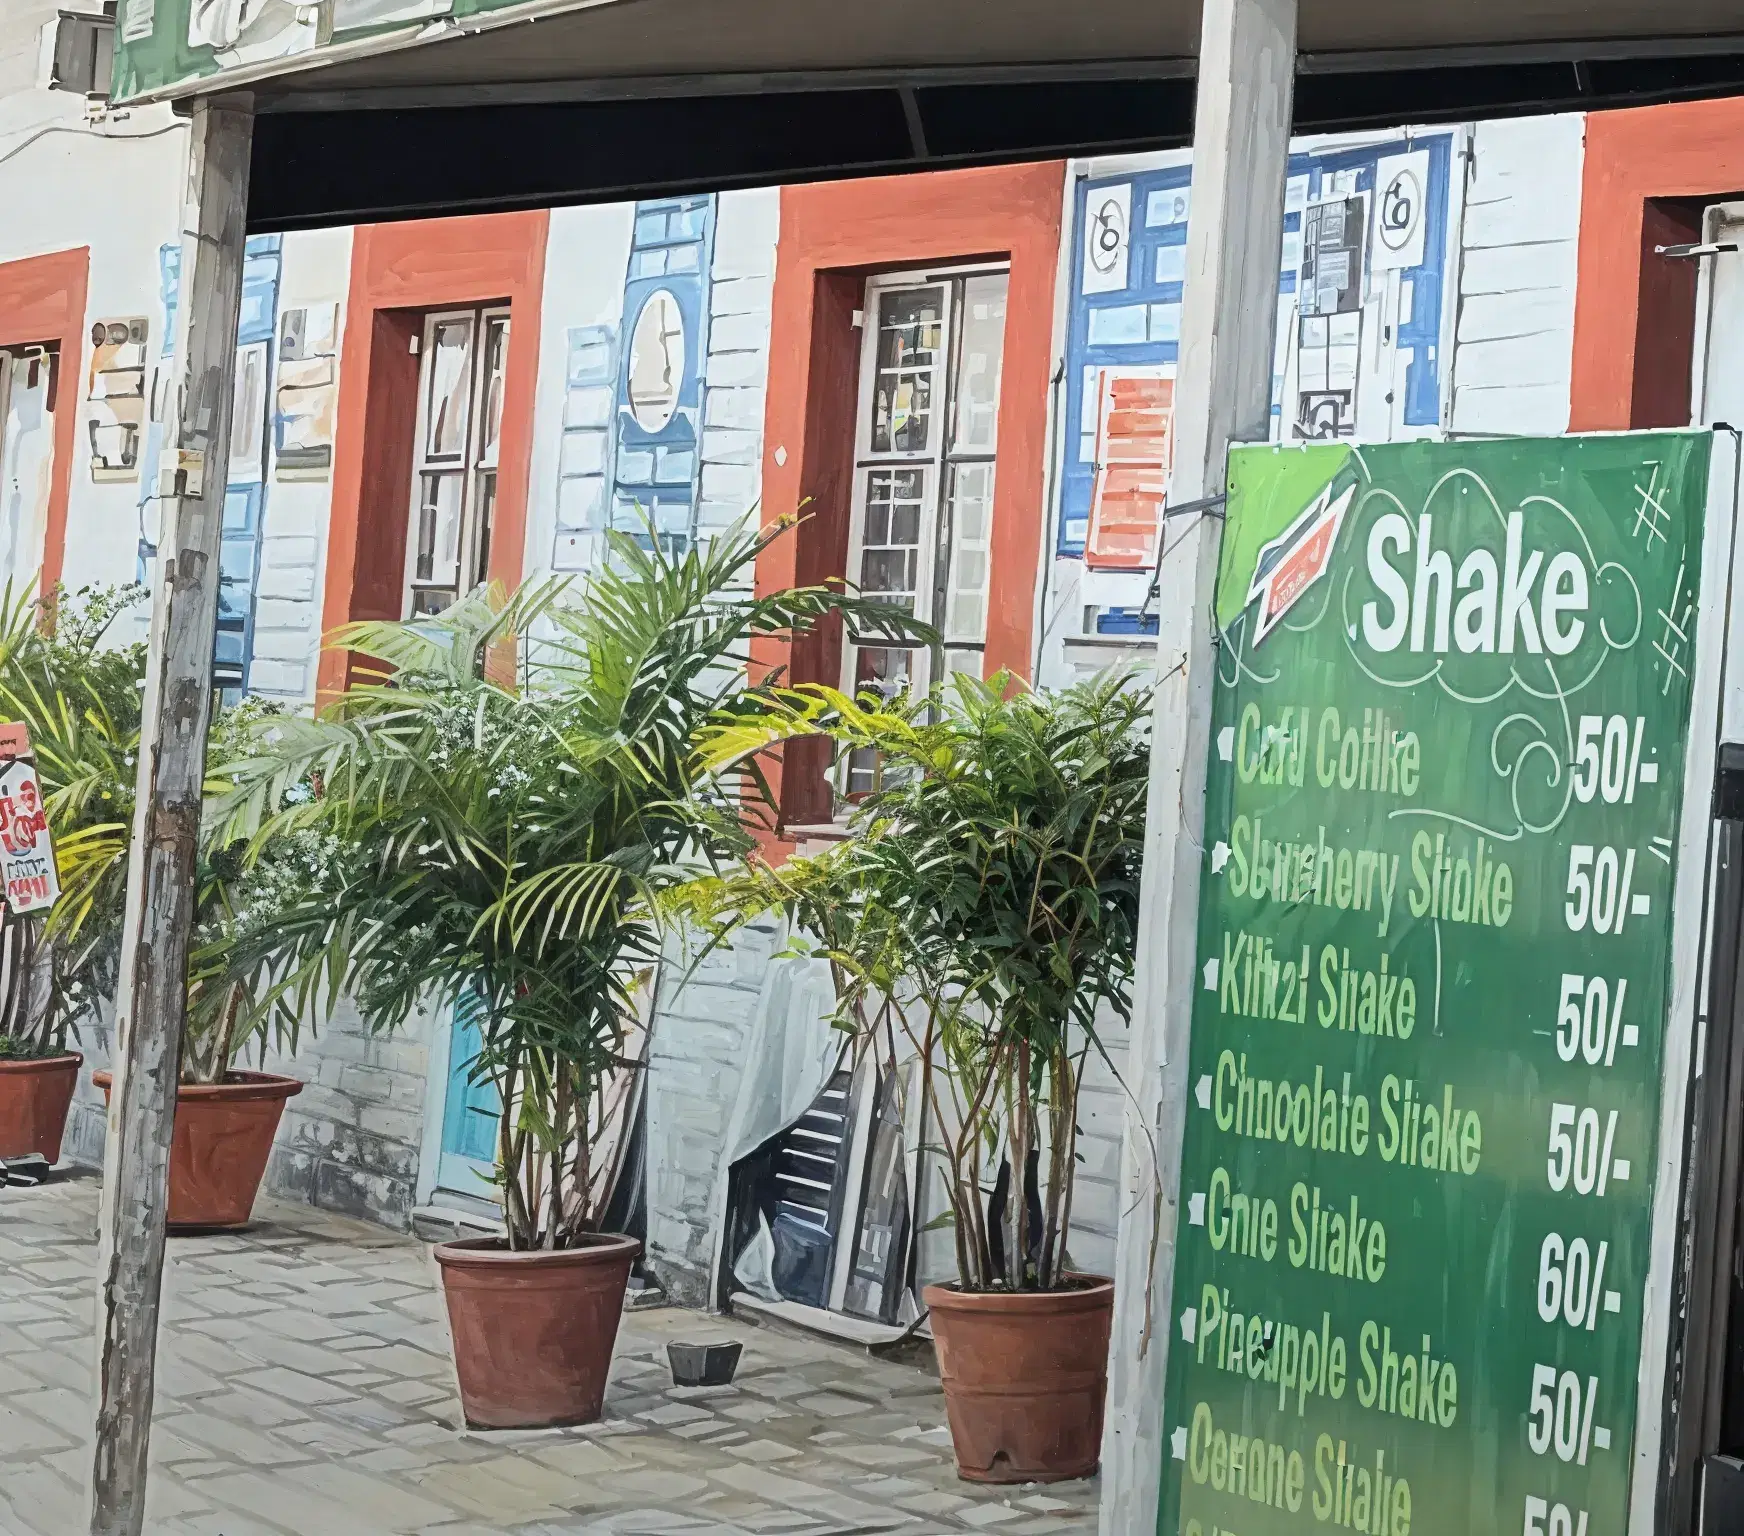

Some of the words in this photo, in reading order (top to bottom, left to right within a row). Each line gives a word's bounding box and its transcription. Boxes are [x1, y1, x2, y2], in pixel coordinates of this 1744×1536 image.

[1362, 511, 1589, 656] Shake
[1573, 715, 1658, 804] 50/-
[1564, 843, 1651, 935] 50/-
[1556, 973, 1639, 1067] 50/-
[1547, 1103, 1631, 1197] 50/-
[1537, 1232, 1621, 1331] 60/-
[1528, 1363, 1611, 1466] 50/-
